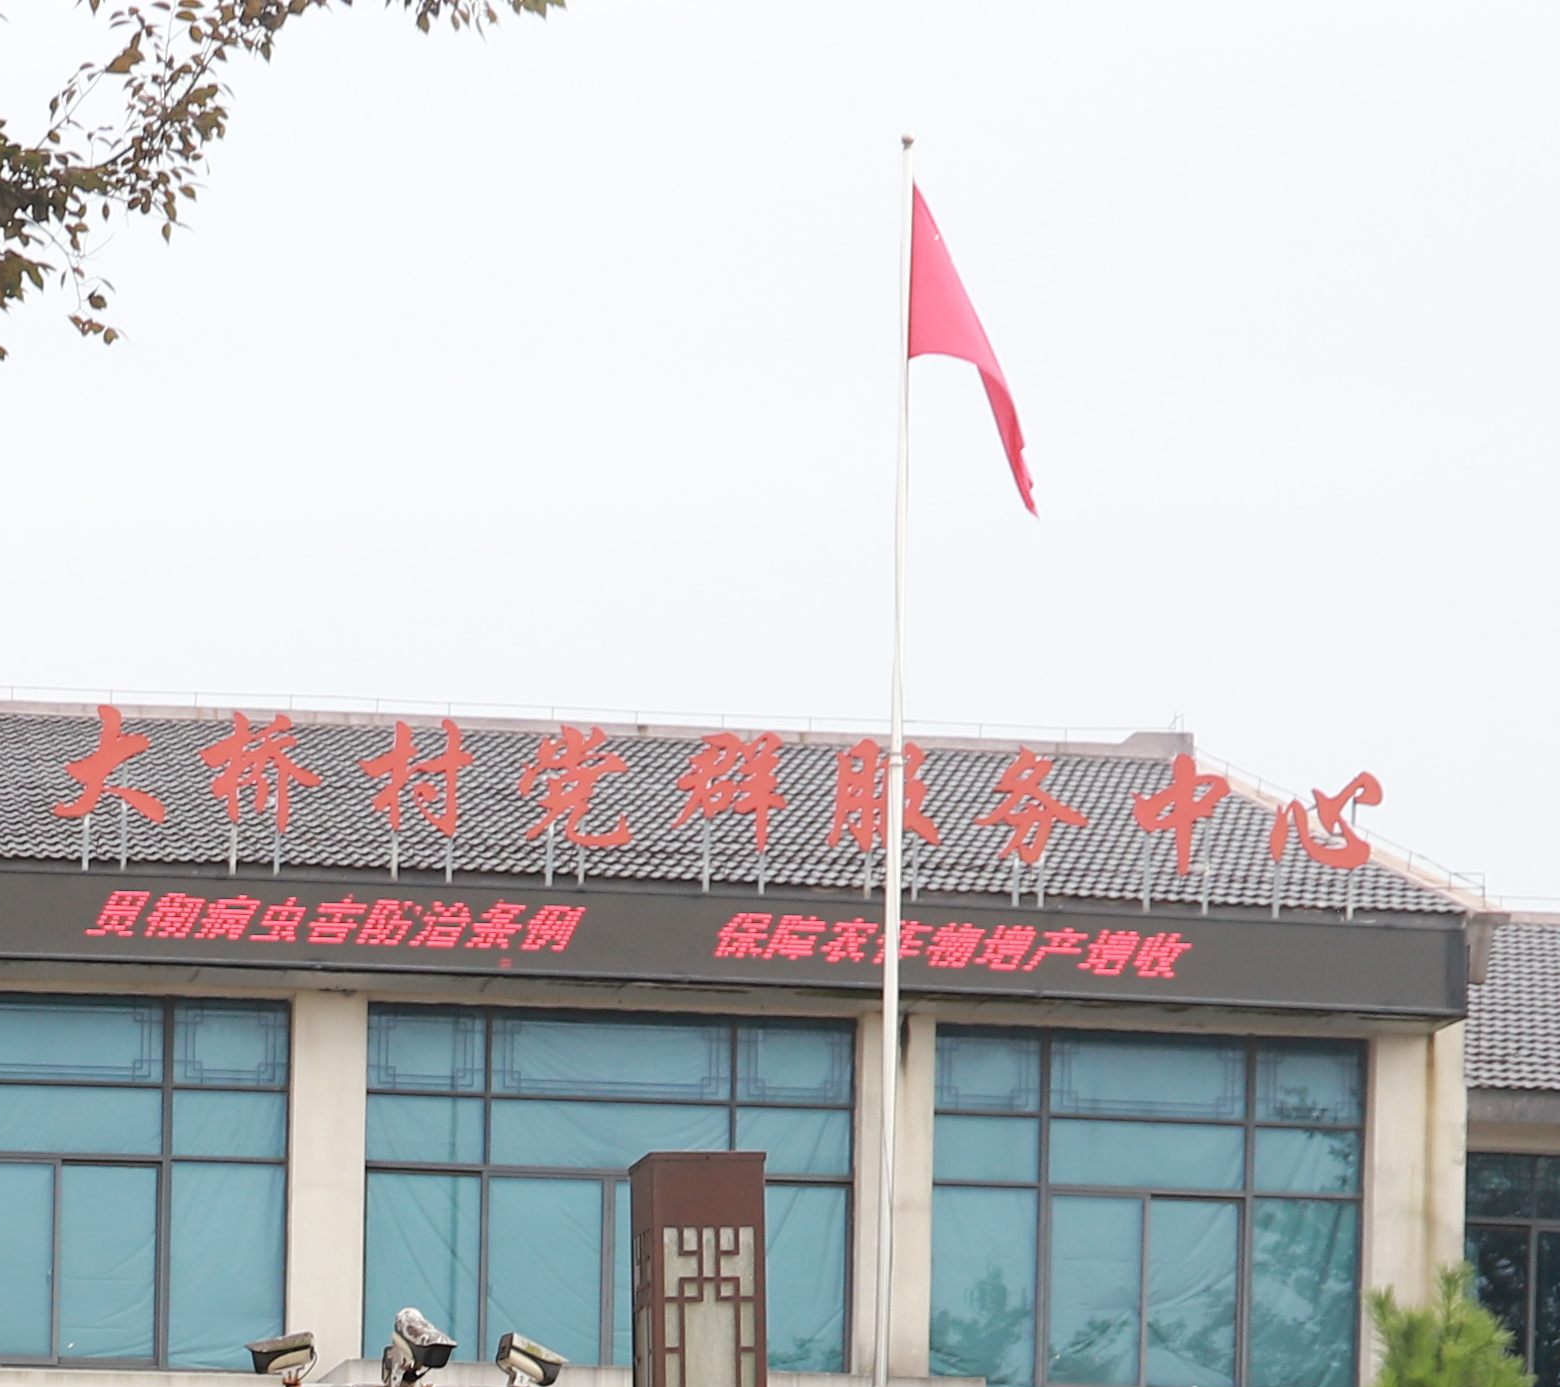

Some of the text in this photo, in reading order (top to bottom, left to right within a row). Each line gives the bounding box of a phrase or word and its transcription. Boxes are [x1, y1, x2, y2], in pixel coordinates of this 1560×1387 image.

[53, 704, 1384, 877] 大桥村党群服务中心
